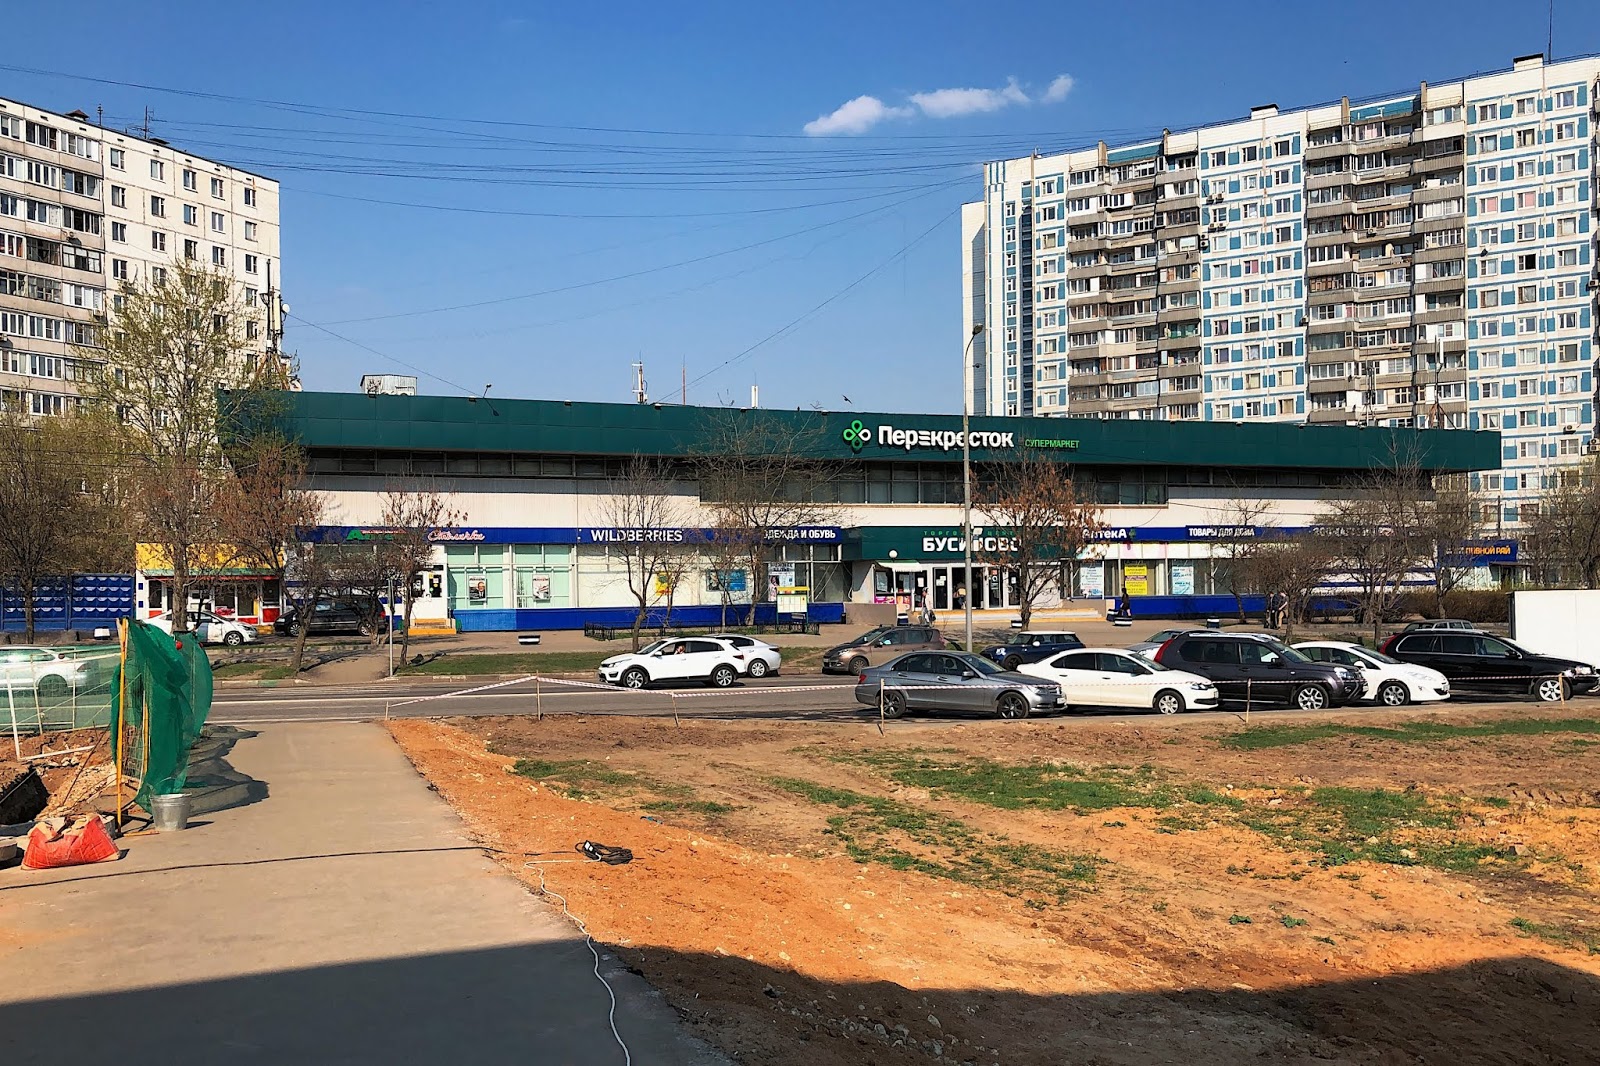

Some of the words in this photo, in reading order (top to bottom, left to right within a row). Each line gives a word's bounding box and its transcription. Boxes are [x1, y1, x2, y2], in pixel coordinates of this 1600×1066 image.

[1024, 438, 1080, 448] СУПЕРМАРКЕТ
[591, 529, 683, 542] WILDBERRIES
[800, 529, 807, 539] И
[808, 529, 837, 539] ОБУВЬ
[1188, 527, 1217, 537] ТОВАРЫ
[1217, 527, 1233, 538] ДЛЯ
[1496, 545, 1511, 555] РАЙ
